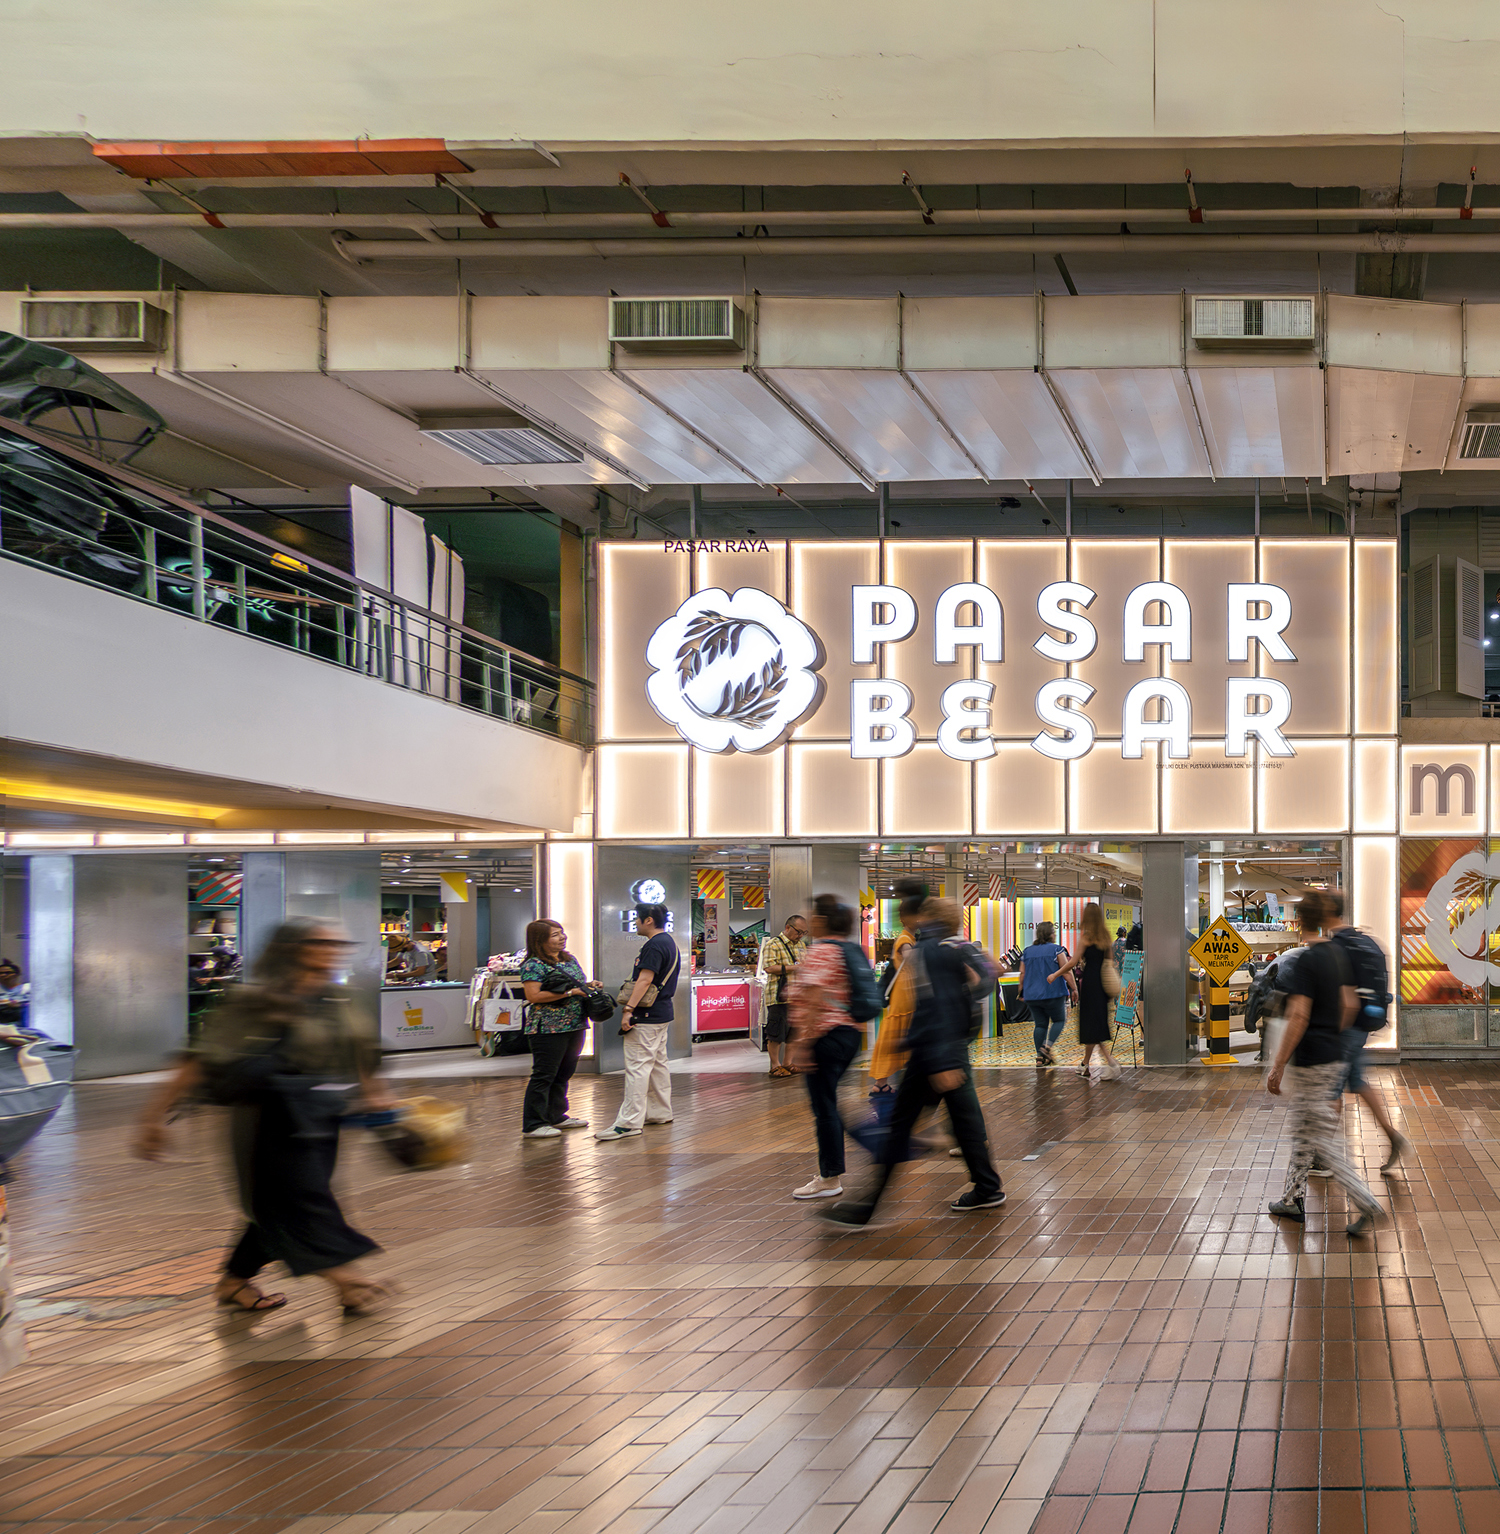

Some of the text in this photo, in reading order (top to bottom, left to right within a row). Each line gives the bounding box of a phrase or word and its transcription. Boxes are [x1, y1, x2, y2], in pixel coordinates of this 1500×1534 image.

[664, 540, 769, 553] PASAR RAYA
[852, 581, 1299, 664] PASAR
[850, 678, 1298, 760] BESAR
[1203, 942, 1239, 954] AWAS
